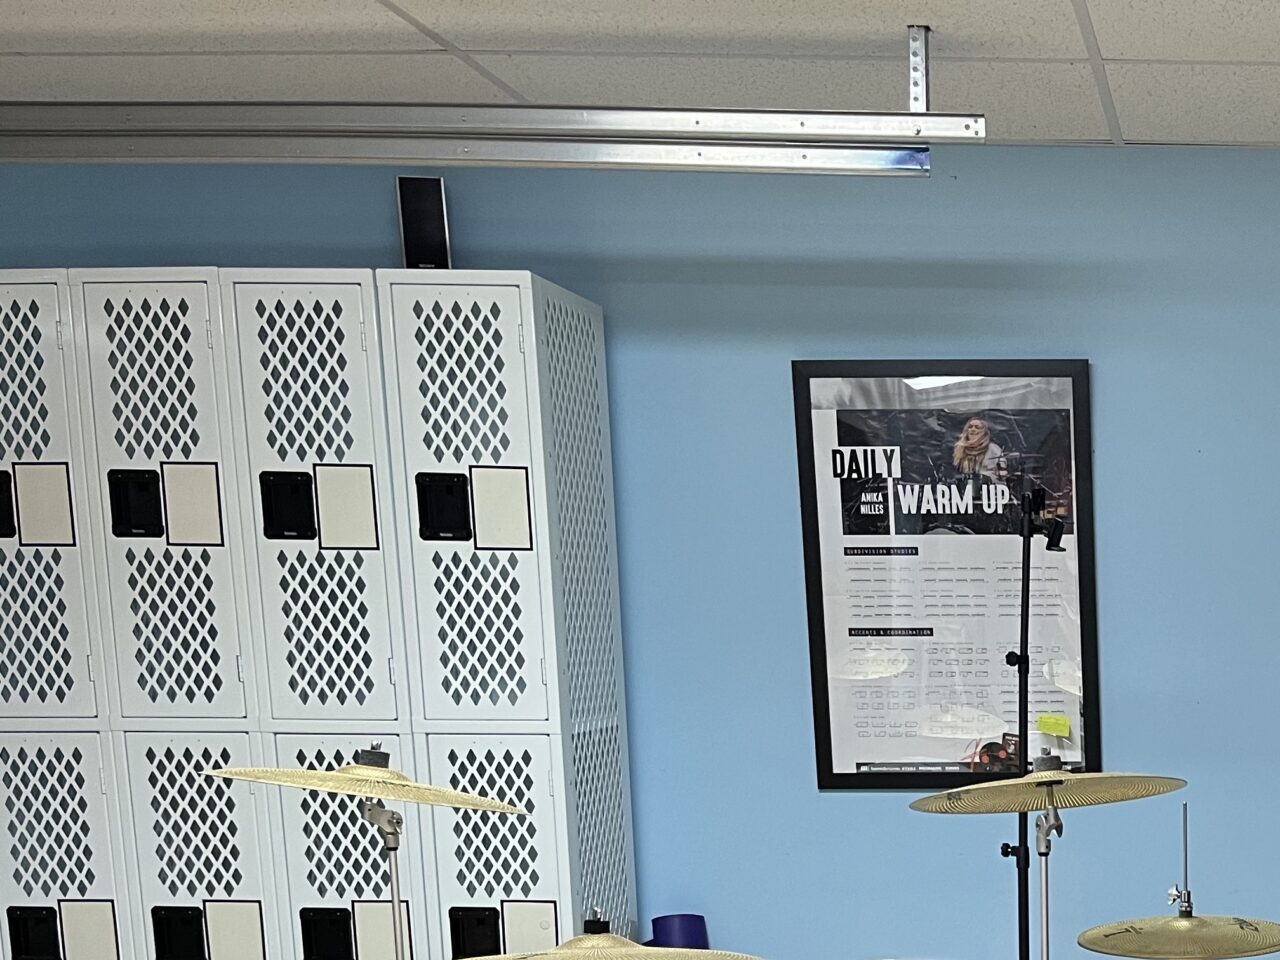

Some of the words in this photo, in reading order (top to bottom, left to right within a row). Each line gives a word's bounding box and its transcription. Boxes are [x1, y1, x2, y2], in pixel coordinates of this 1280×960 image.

[832, 448, 896, 479] DAILY
[860, 492, 884, 503] ANIKA
[897, 484, 973, 515] WARM
[981, 484, 1010, 514] UP
[860, 504, 884, 515] NILLES
